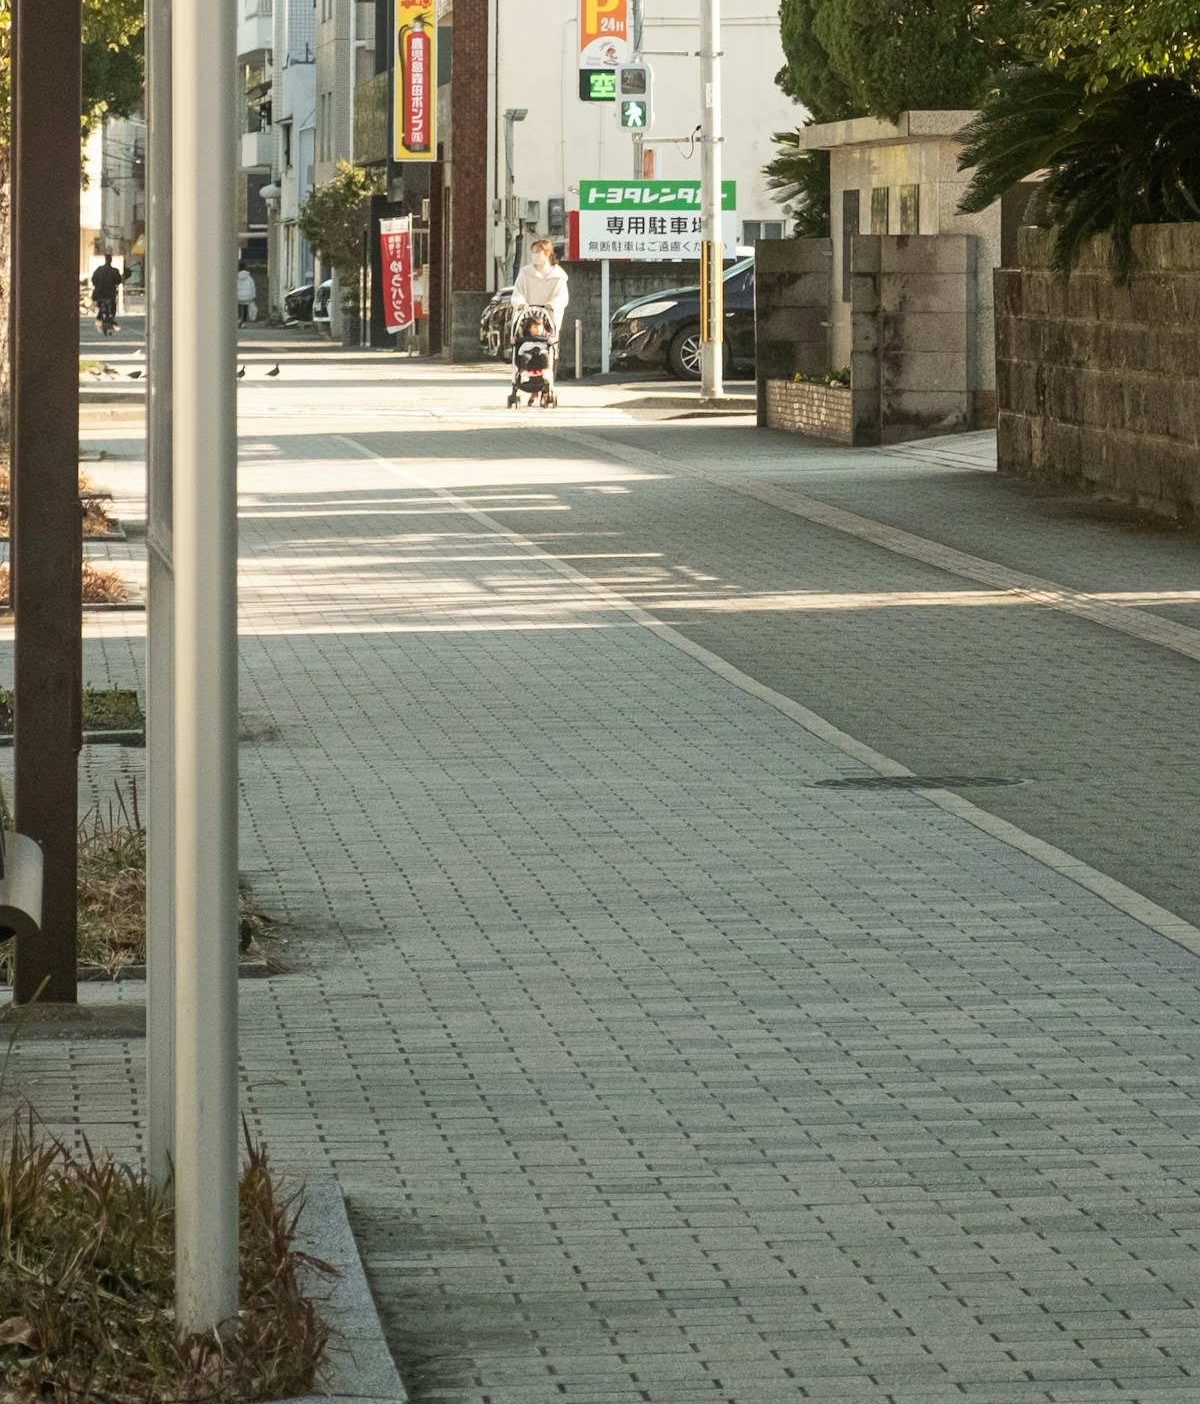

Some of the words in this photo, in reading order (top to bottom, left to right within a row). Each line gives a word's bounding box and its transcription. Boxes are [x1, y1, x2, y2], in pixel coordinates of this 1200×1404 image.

[600, 17, 624, 32] 24H
[589, 73, 616, 98] 空
[588, 241, 728, 253] 無断駐車はご遠慮くだ
[390, 260, 405, 324] ゆうパック
